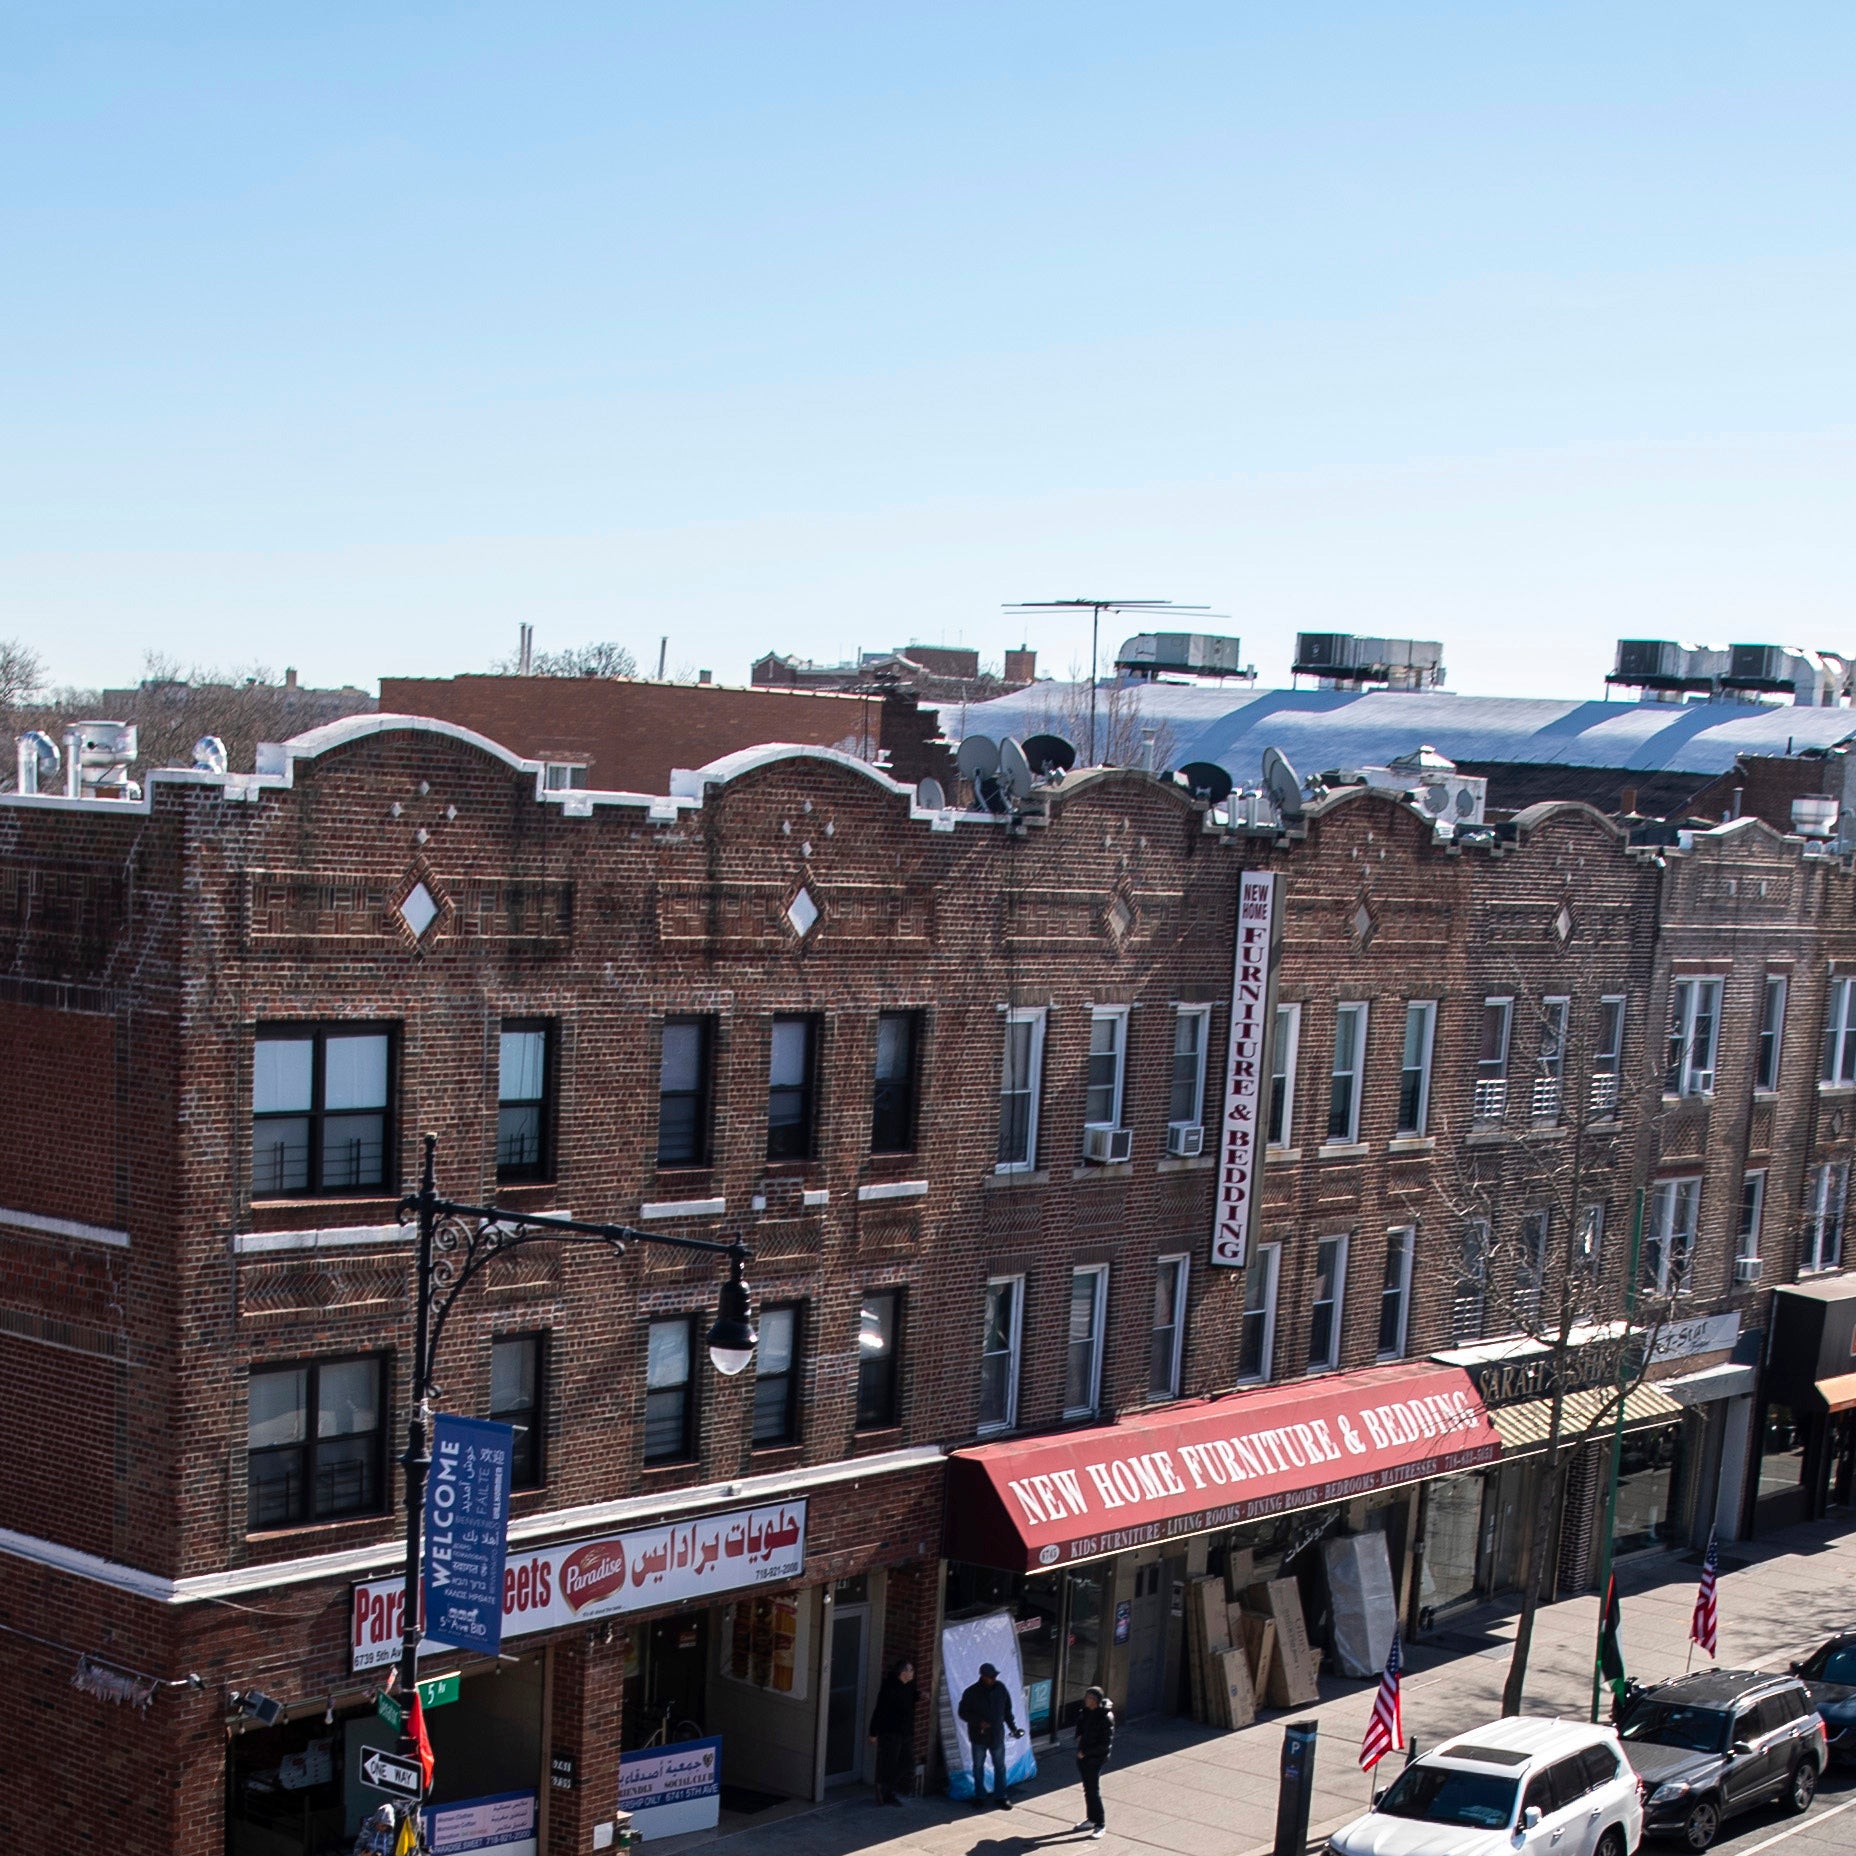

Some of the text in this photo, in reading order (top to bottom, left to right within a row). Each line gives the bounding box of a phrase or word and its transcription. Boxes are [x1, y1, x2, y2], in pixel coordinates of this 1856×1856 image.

[1244, 883, 1269, 903] NEW
[1242, 901, 1268, 921] HOME
[1216, 926, 1267, 1261] FURNITURE & BEDDING
[1008, 1390, 1480, 1527] NEW HOME FURNITURE & BEDDING
[431, 1440, 461, 1589] WELCOME
[1070, 1537, 1097, 1559] KIDS
[1099, 1522, 1161, 1554] FURNITURE
[1166, 1512, 1202, 1536] LIVING
[1204, 1504, 1241, 1528] ROOMS
[1246, 1497, 1283, 1518] DINING
[1284, 1489, 1319, 1508] ROOMS
[1324, 1475, 1376, 1500] BEDROOMS
[1380, 1459, 1437, 1487] MATTRESSES
[631, 1508, 801, 1588] حلويات برادايس
[565, 1556, 623, 1595] Paradise
[354, 1652, 375, 1667] 6739
[375, 1648, 390, 1663] 5th
[427, 1684, 435, 1704] 5
[1291, 1741, 1301, 1755] P
[370, 1757, 412, 1787] ONE WAY
[644, 1795, 661, 1806] ONLY
[685, 1786, 702, 1798] 5TH
[703, 1783, 719, 1795] AVE
